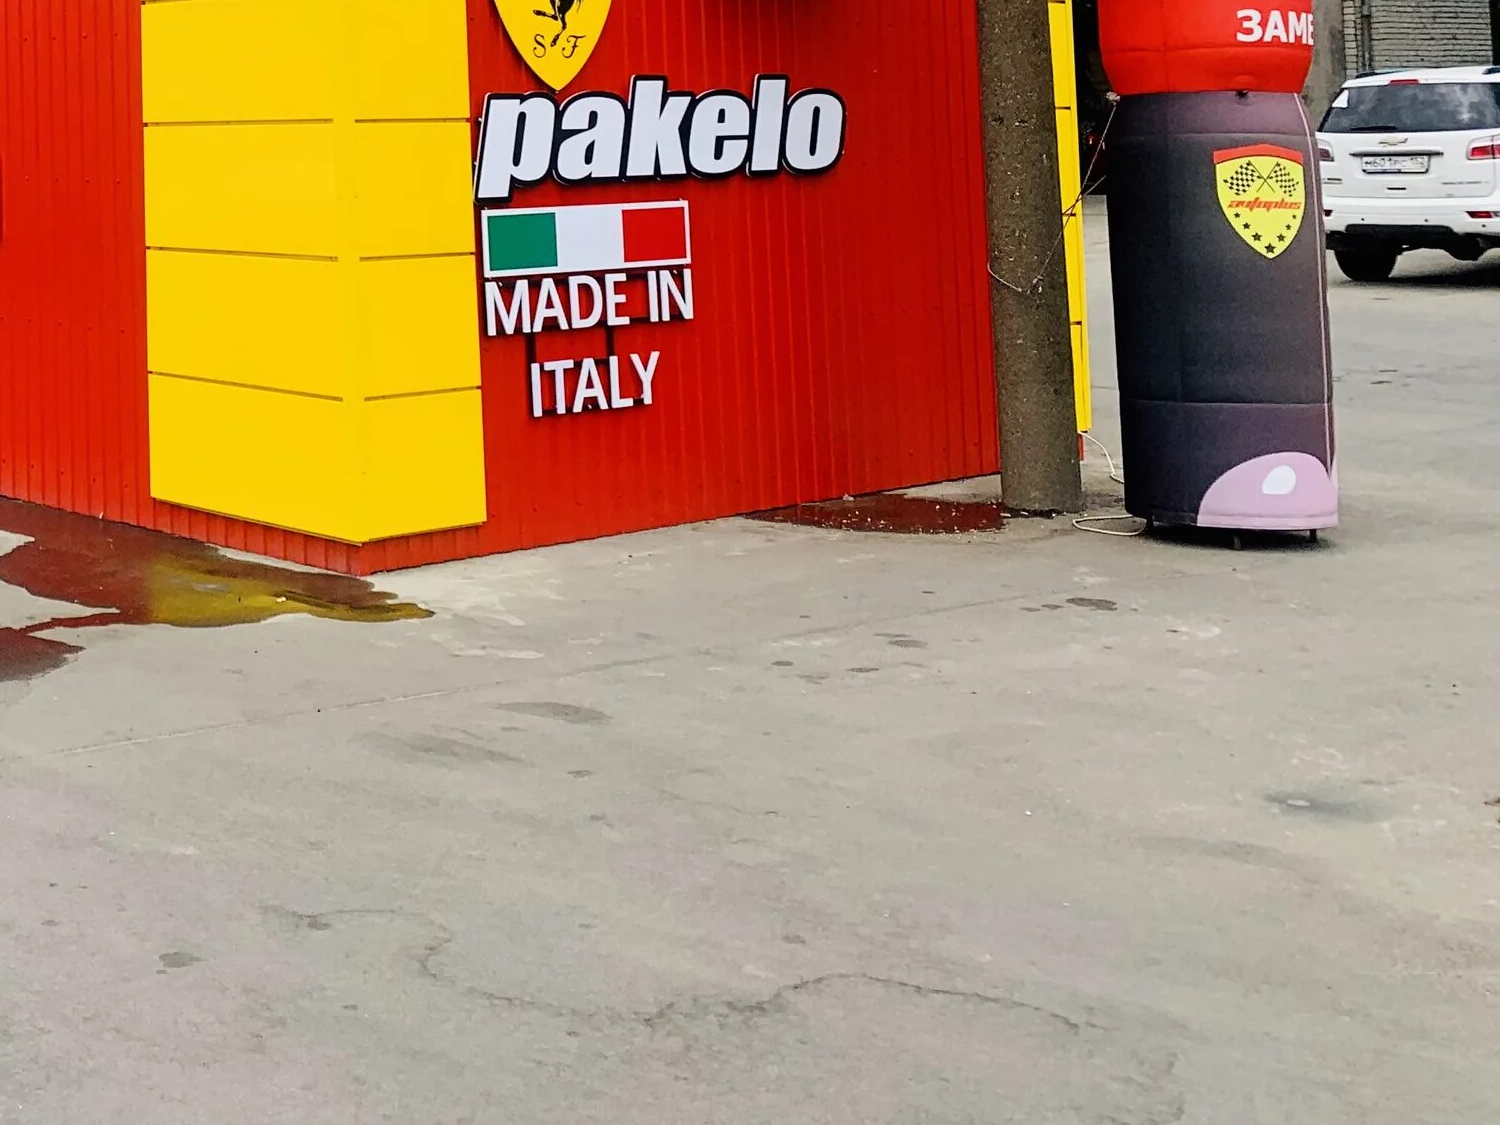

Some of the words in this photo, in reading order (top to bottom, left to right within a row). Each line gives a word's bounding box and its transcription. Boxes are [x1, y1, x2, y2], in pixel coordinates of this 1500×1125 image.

[533, 33, 547, 58] S
[561, 34, 587, 59] F
[474, 74, 847, 203] pakelo
[484, 273, 631, 337] MADE
[647, 268, 694, 323] IN
[530, 350, 660, 418] ITALY
